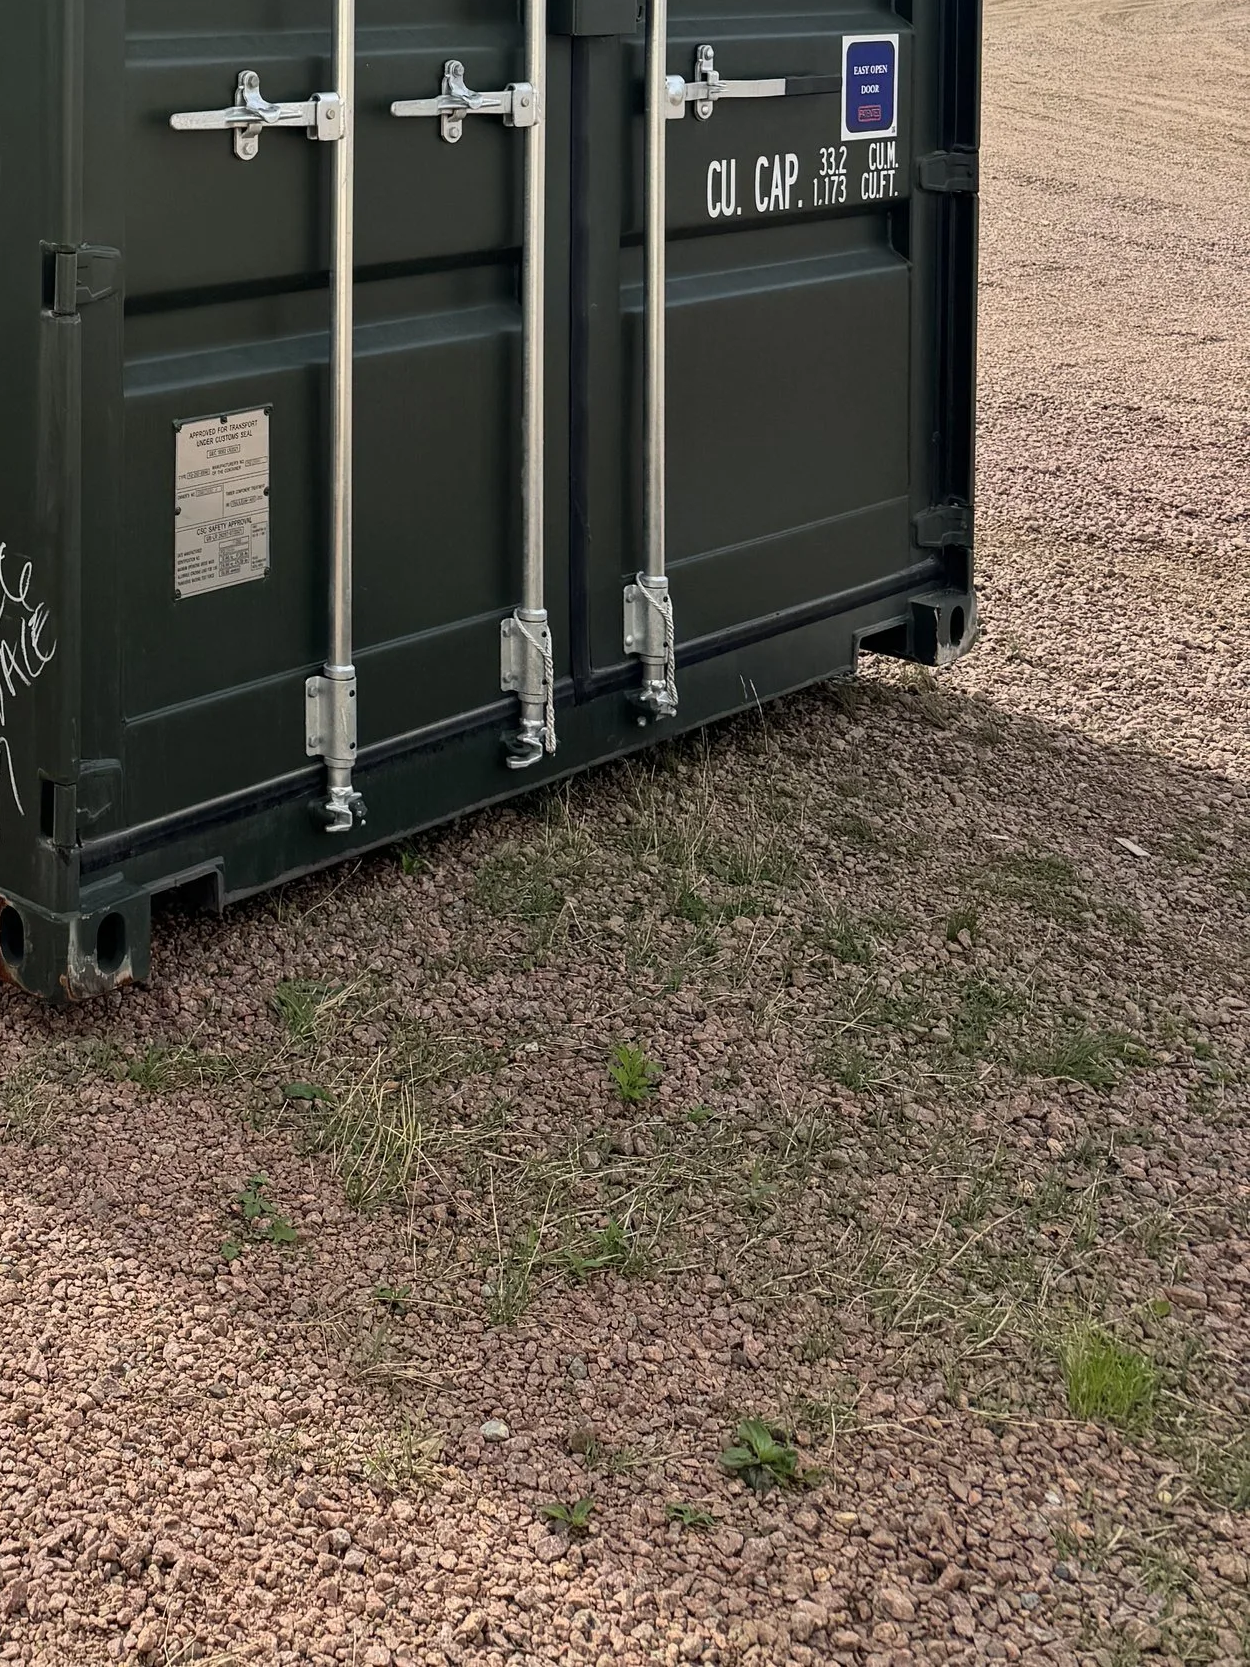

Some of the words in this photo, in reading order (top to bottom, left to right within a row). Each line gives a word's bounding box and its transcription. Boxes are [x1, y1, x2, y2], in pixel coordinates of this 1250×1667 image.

[854, 65, 869, 76] EASY
[870, 64, 888, 74] OPEN
[861, 84, 880, 94] DOOR
[707, 159, 742, 218] CU.
[755, 153, 803, 213] CAP.
[819, 146, 847, 176] 33.2
[869, 141, 899, 171] CU.M.
[813, 175, 847, 206] 1,173
[861, 170, 898, 200] CU.FT.
[189, 428, 216, 439] APPROVED
[217, 425, 228, 434] FOR
[229, 420, 258, 431] TRANSPORT
[196, 437, 214, 447] UNDER
[215, 433, 239, 444] CUSTOMS
[241, 430, 253, 439] SEAL
[196, 528, 207, 536] CSC
[209, 523, 227, 533] SAFETY
[228, 517, 252, 528] APPROVAL
